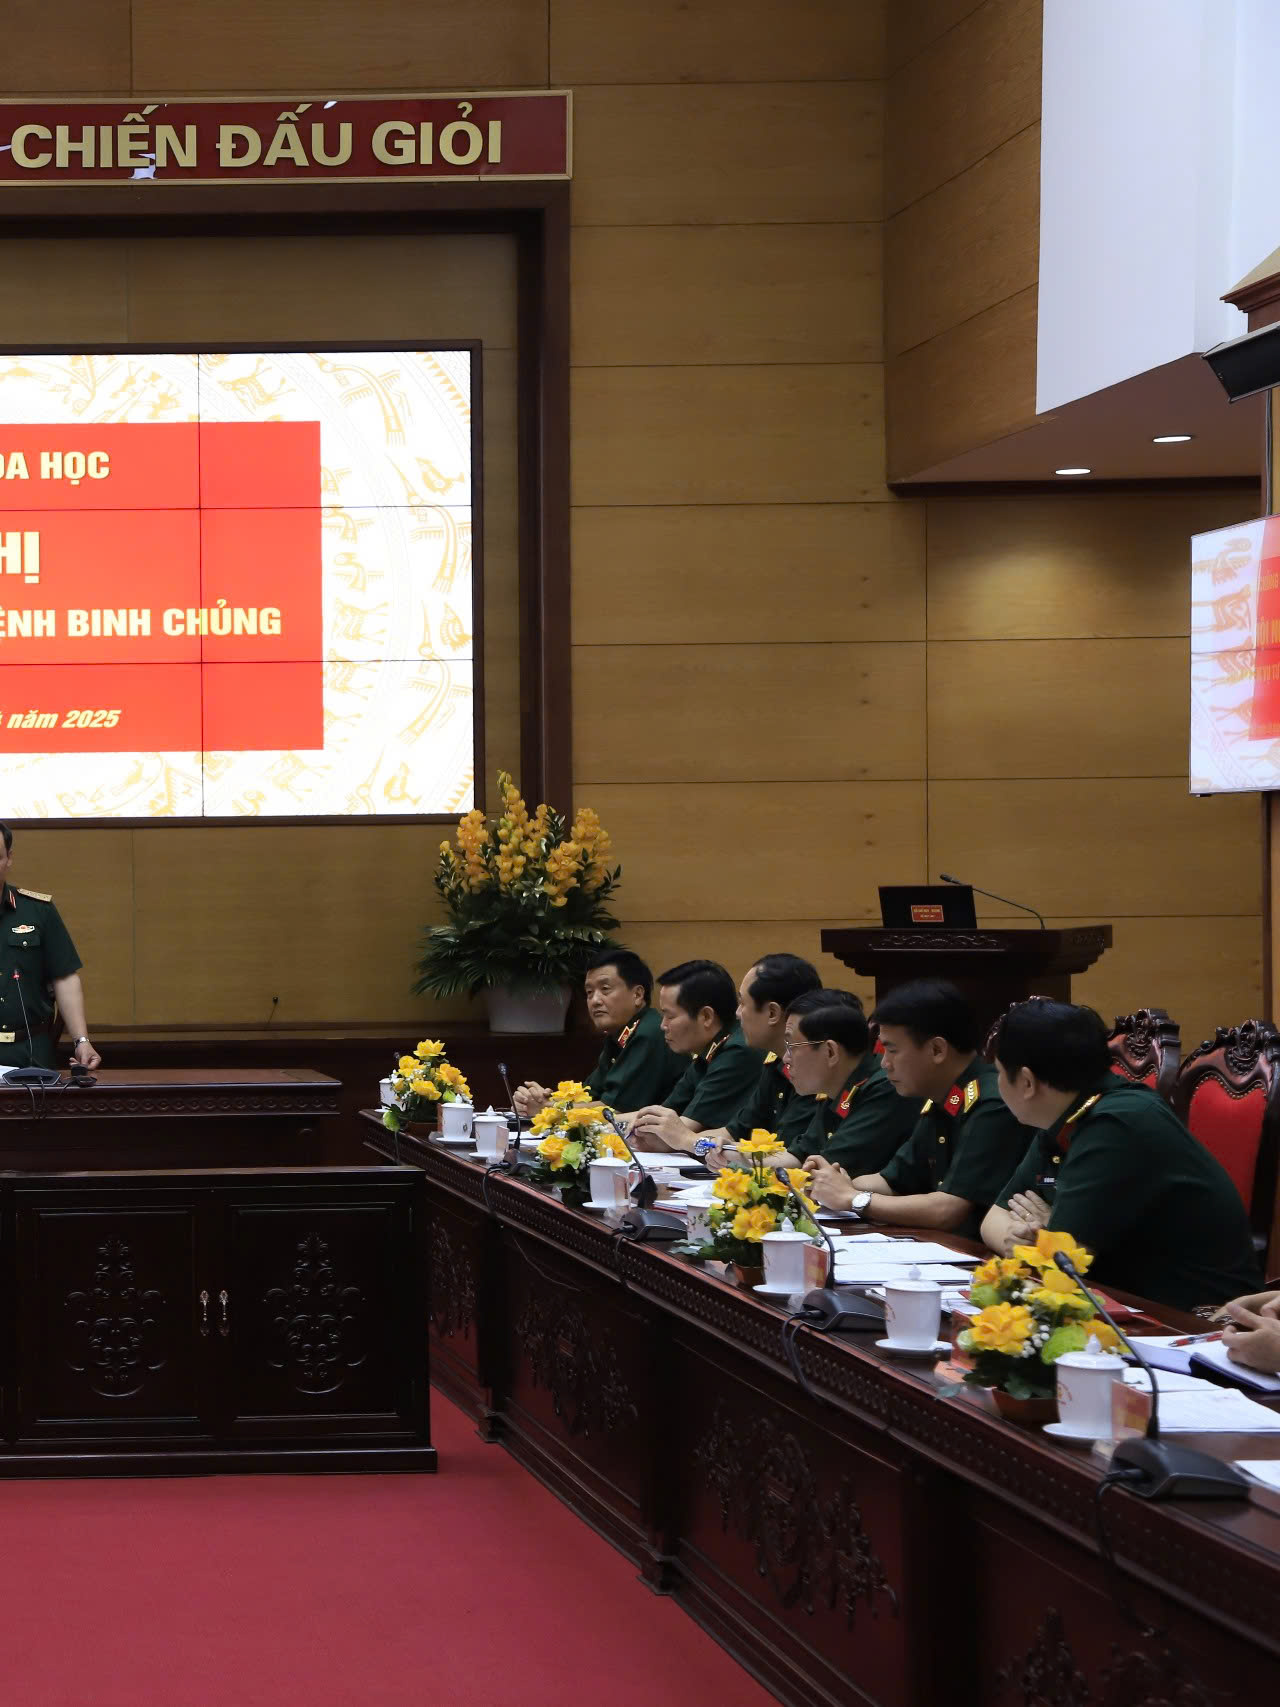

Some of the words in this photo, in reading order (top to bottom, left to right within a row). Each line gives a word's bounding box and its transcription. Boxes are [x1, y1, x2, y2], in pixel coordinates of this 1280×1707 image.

[12, 104, 198, 169] CHIẾN
[215, 103, 353, 167] ĐẤU
[371, 101, 503, 166] GIỎI
[40, 451, 110, 486] HỌC
[67, 608, 152, 637] BINH
[162, 599, 282, 637] CHỦNG
[6, 710, 59, 729] năm
[61, 709, 122, 729] 2025
